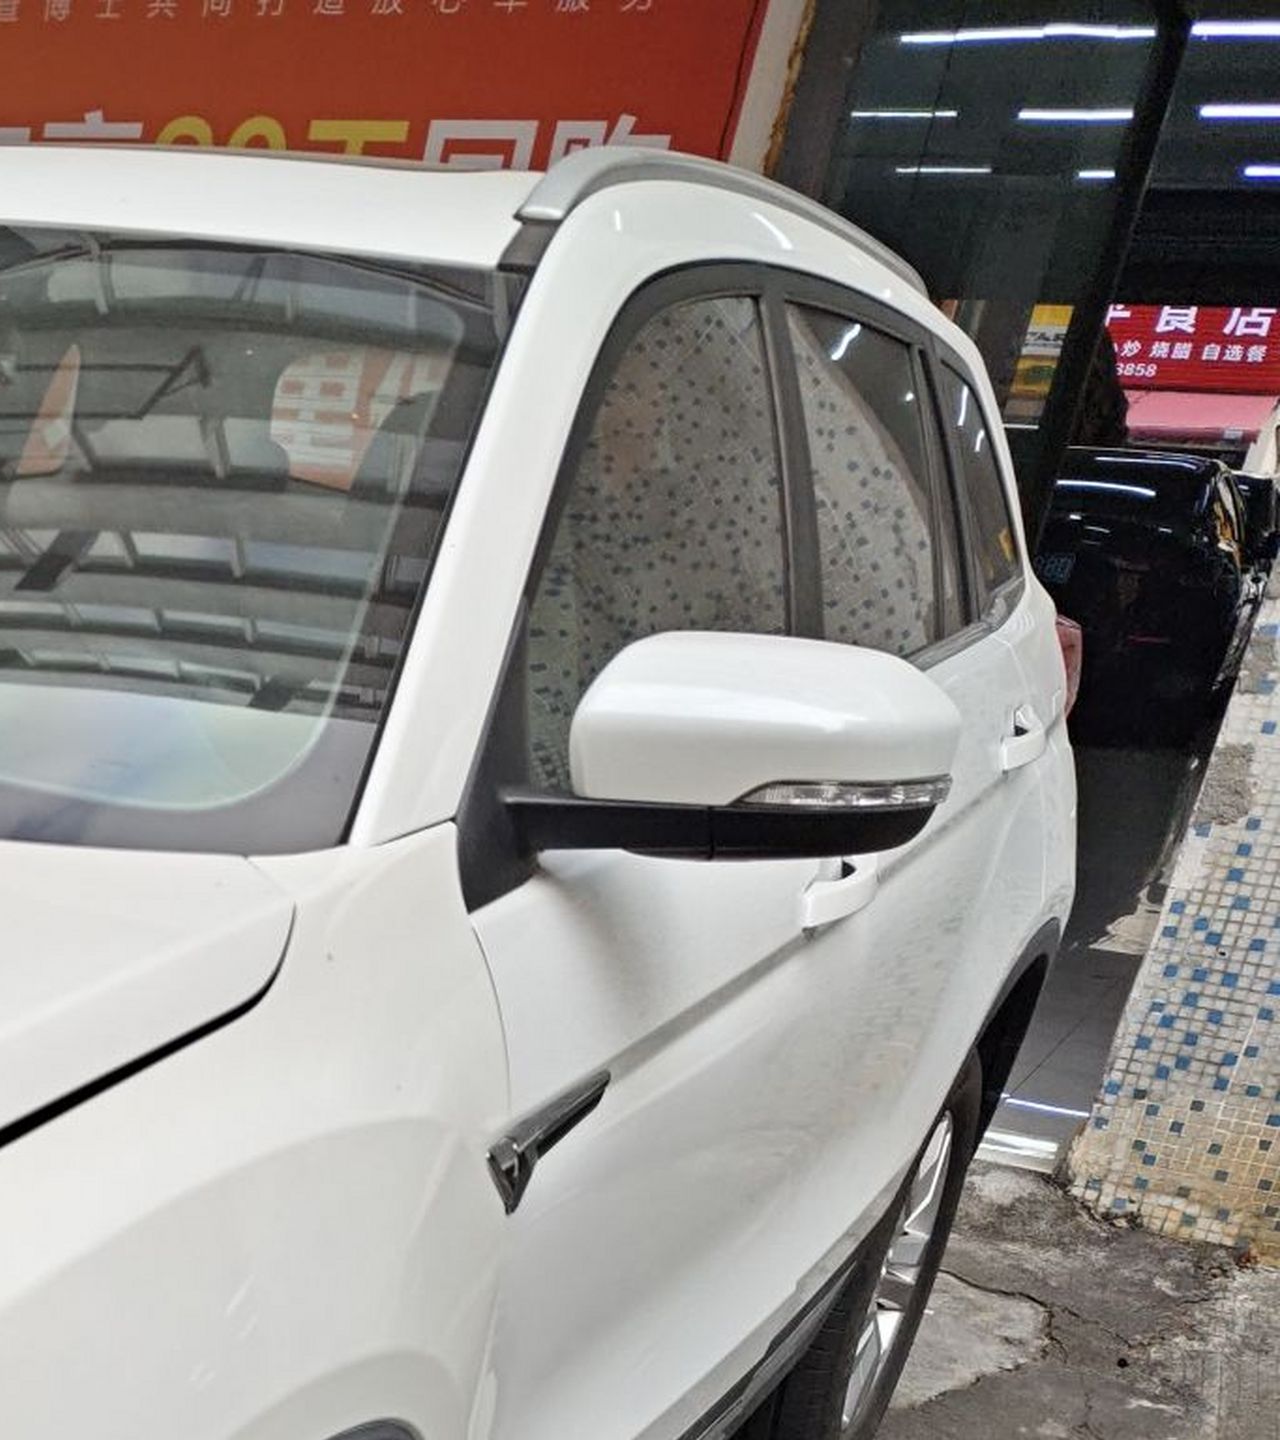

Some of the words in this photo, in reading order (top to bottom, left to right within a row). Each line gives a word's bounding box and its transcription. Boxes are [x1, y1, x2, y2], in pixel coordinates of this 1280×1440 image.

[1114, 340, 1142, 357] 炒
[1201, 343, 1268, 363] 自选餐
